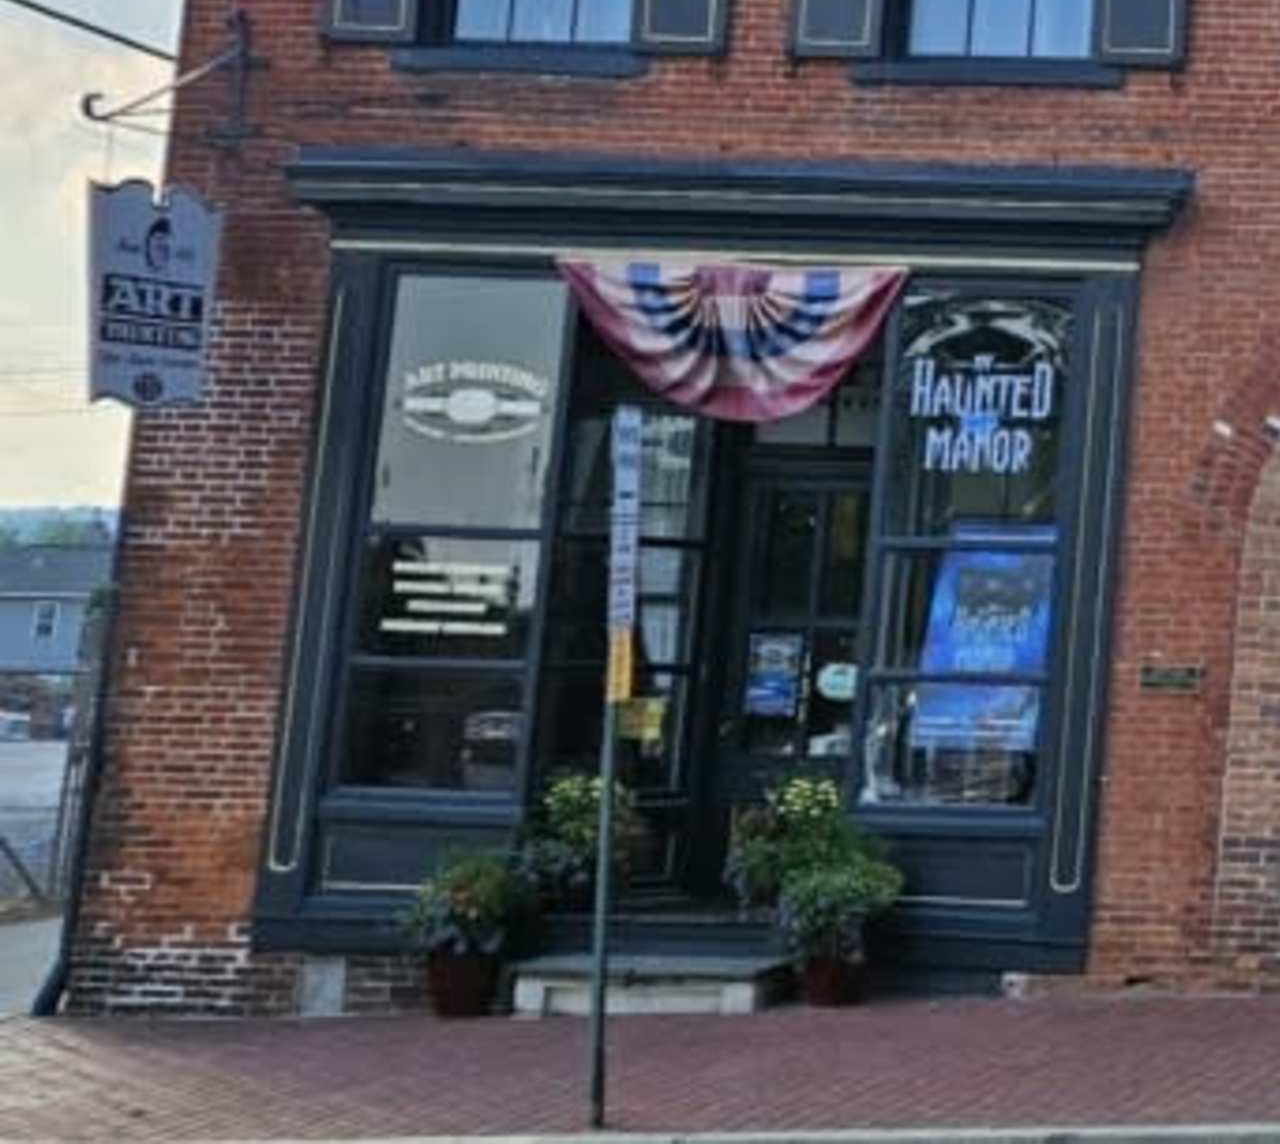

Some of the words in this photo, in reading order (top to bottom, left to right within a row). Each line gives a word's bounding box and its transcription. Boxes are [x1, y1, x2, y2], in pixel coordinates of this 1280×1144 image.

[107, 278, 200, 319] ART
[910, 358, 1054, 418] HAUNTED
[924, 426, 1033, 474] MANOR
